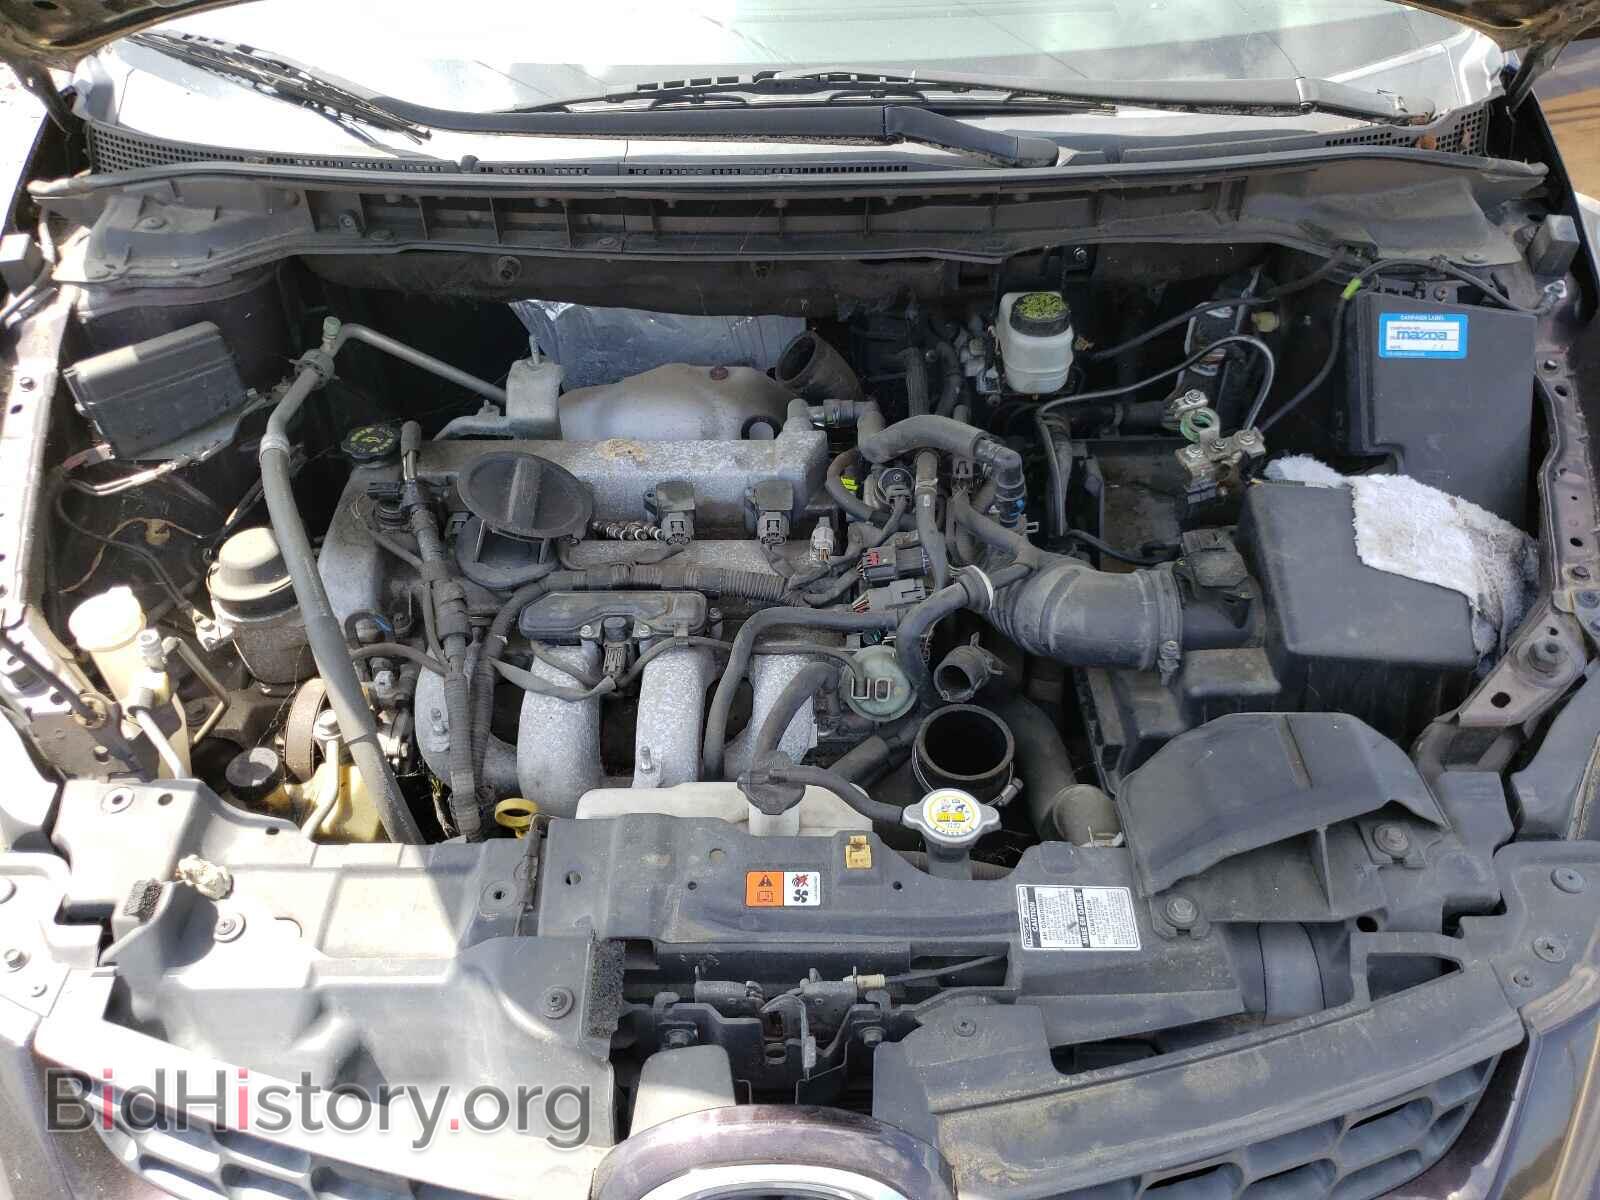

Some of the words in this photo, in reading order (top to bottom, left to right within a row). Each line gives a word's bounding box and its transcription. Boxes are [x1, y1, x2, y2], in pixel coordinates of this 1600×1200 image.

[1397, 330, 1448, 341] mazda
[1075, 891, 1085, 915] GARDE
[1029, 901, 1039, 931] CAUTION
[1079, 916, 1086, 926] EN
[1022, 917, 1033, 946] mazda
[1080, 926, 1089, 944] MISE
